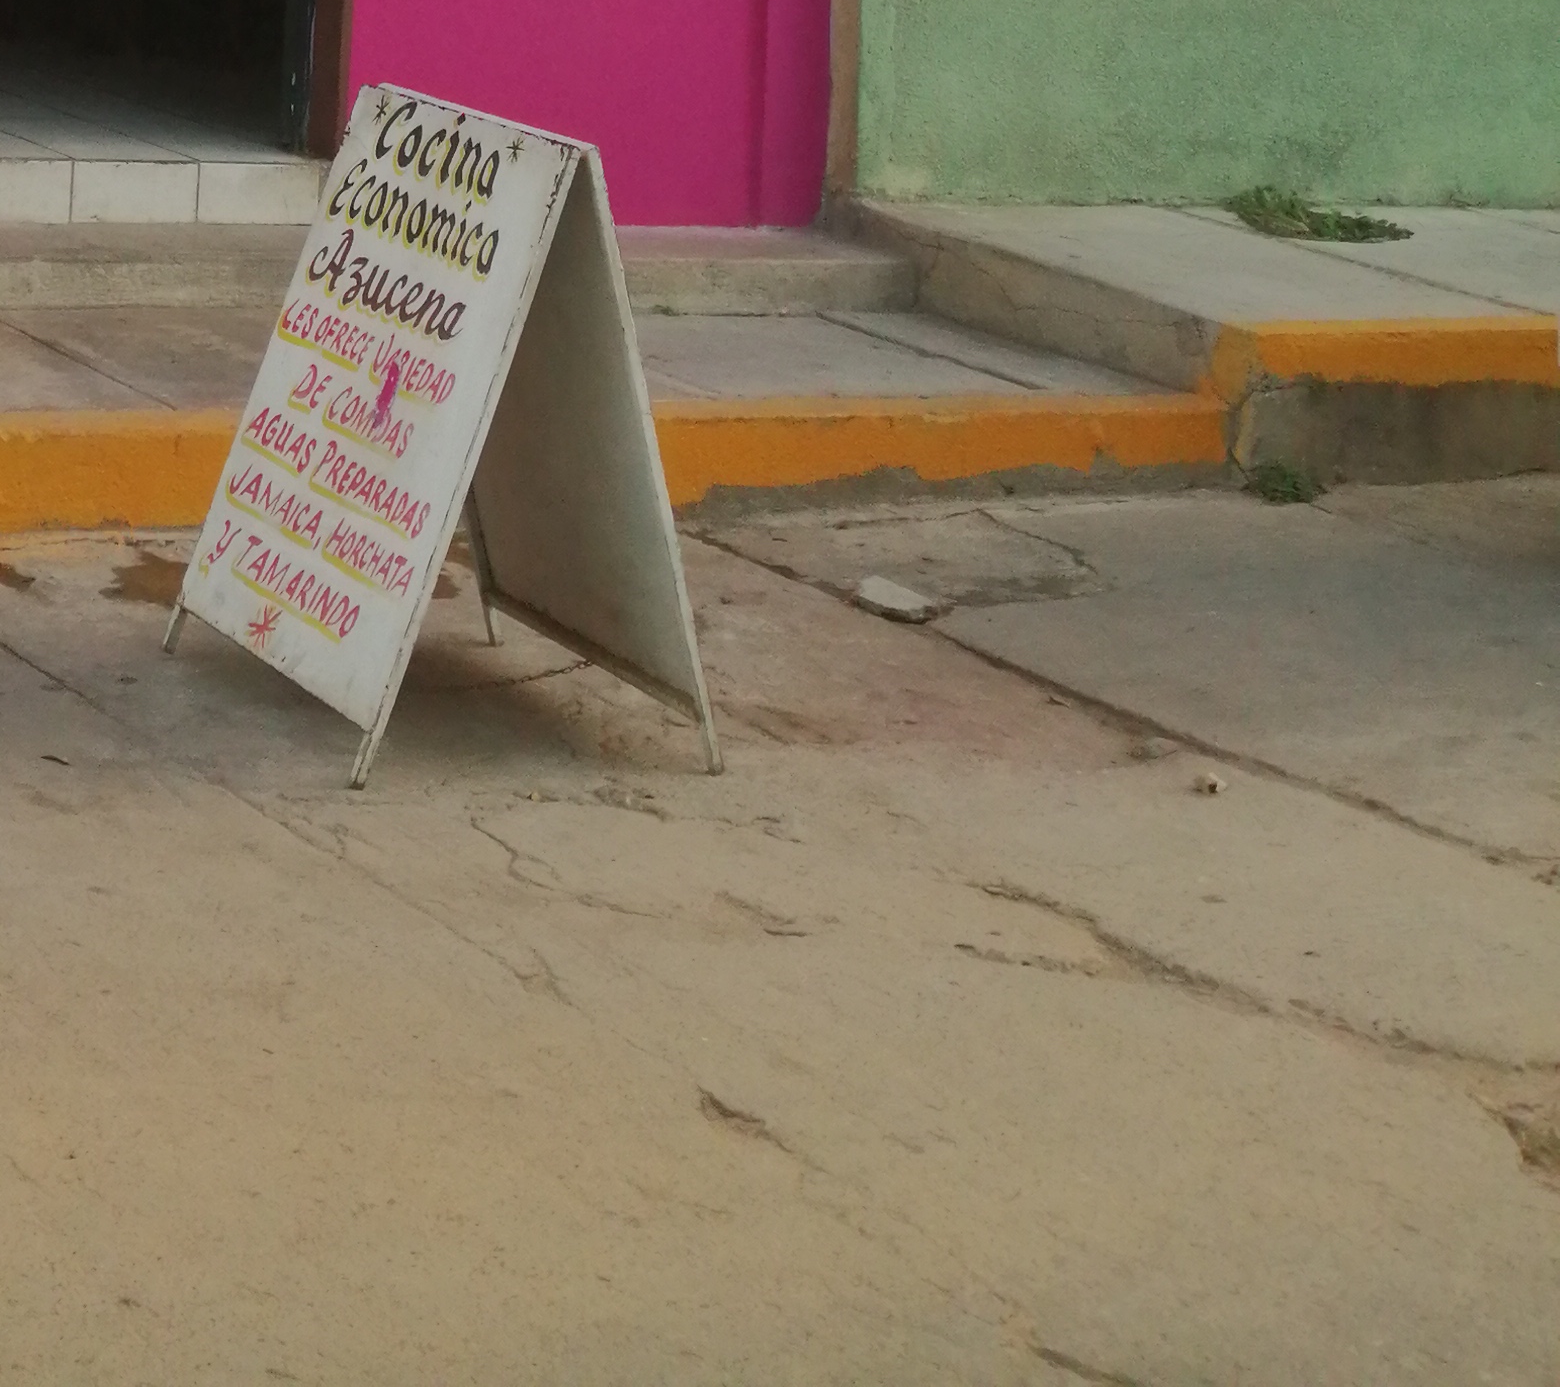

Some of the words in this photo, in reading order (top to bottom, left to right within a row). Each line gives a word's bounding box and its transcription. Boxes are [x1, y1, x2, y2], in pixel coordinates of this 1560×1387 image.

[374, 101, 500, 200] Cocina
[328, 159, 500, 275] Economica
[282, 299, 320, 340] LES
[314, 315, 376, 366] OFRECE
[307, 228, 467, 340] Azucena
[292, 364, 333, 409] DE
[244, 407, 317, 474] AGUAS
[312, 440, 431, 539] PREPARADAS
[228, 464, 324, 551] JAMAICA,
[325, 517, 415, 598] HORCHATA
[236, 535, 361, 649] TAMARINDO
